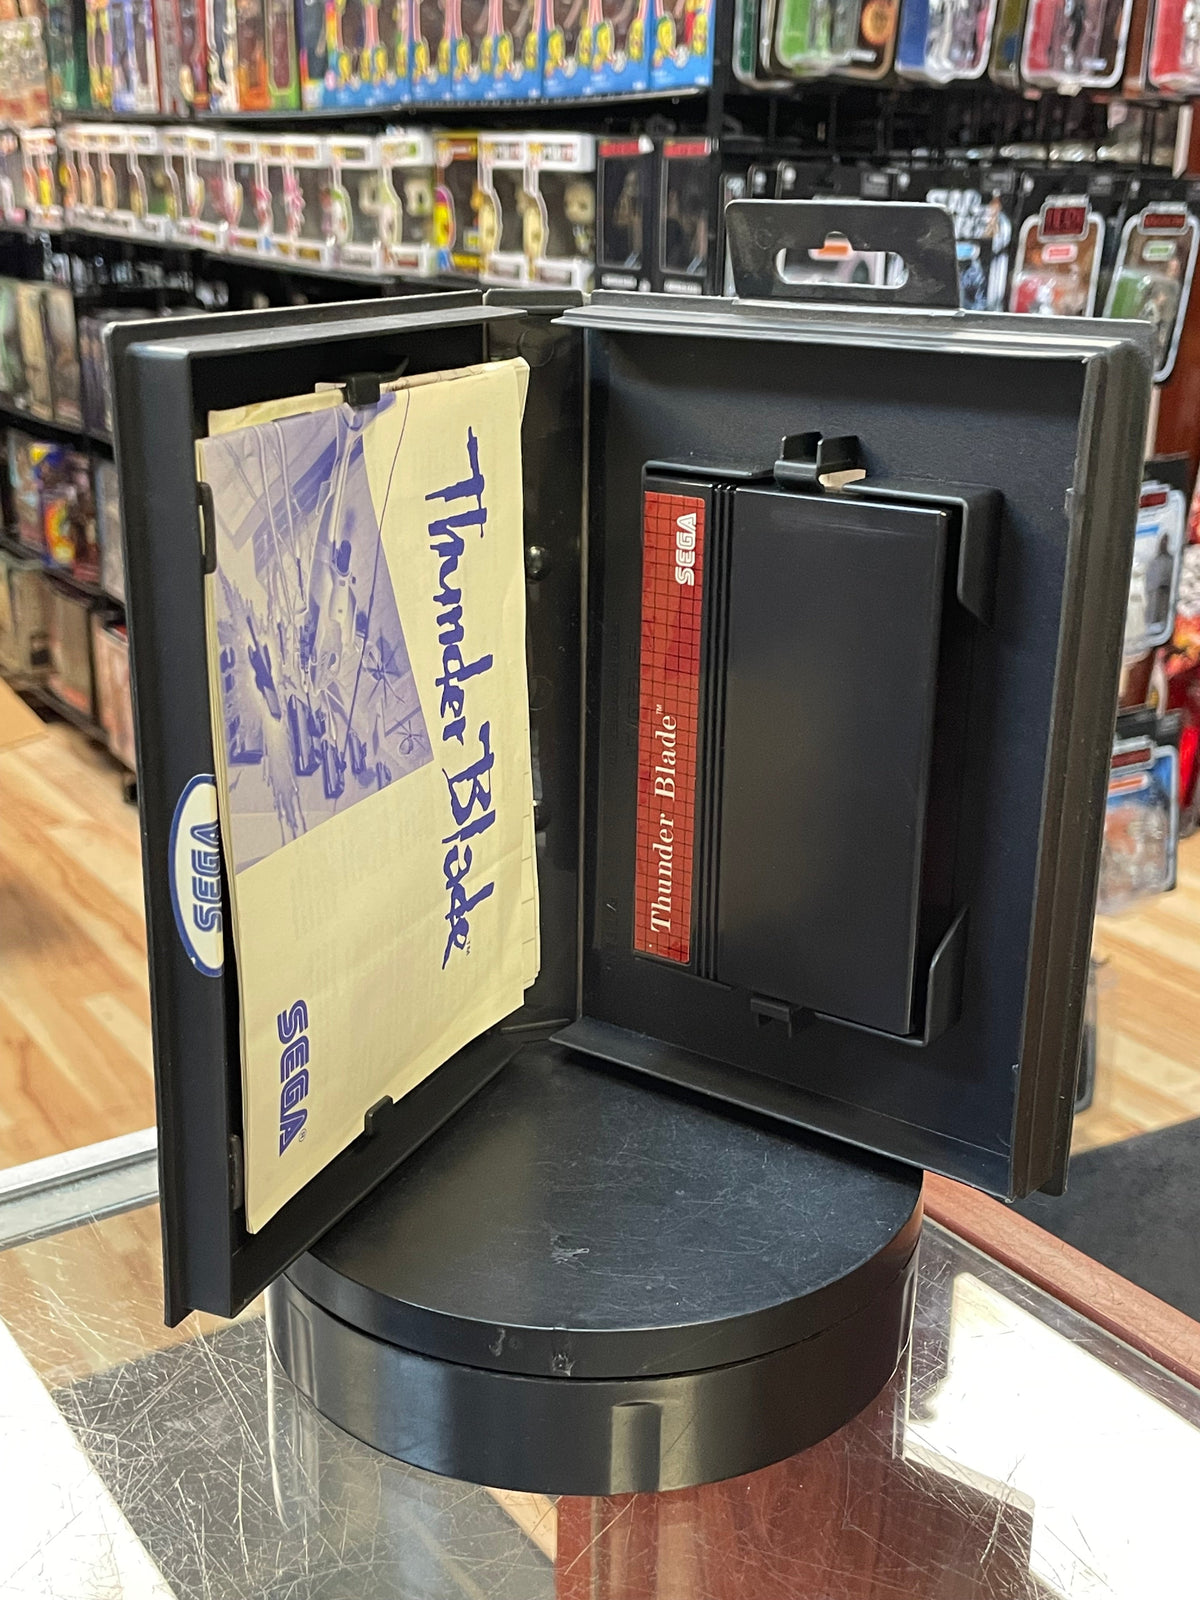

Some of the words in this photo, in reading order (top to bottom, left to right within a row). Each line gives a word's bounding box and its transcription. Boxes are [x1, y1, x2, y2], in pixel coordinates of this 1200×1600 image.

[425, 426, 494, 746] Thunder
[674, 512, 698, 586] SEGA
[190, 819, 222, 933] SEGA
[651, 812, 674, 933] Thunder
